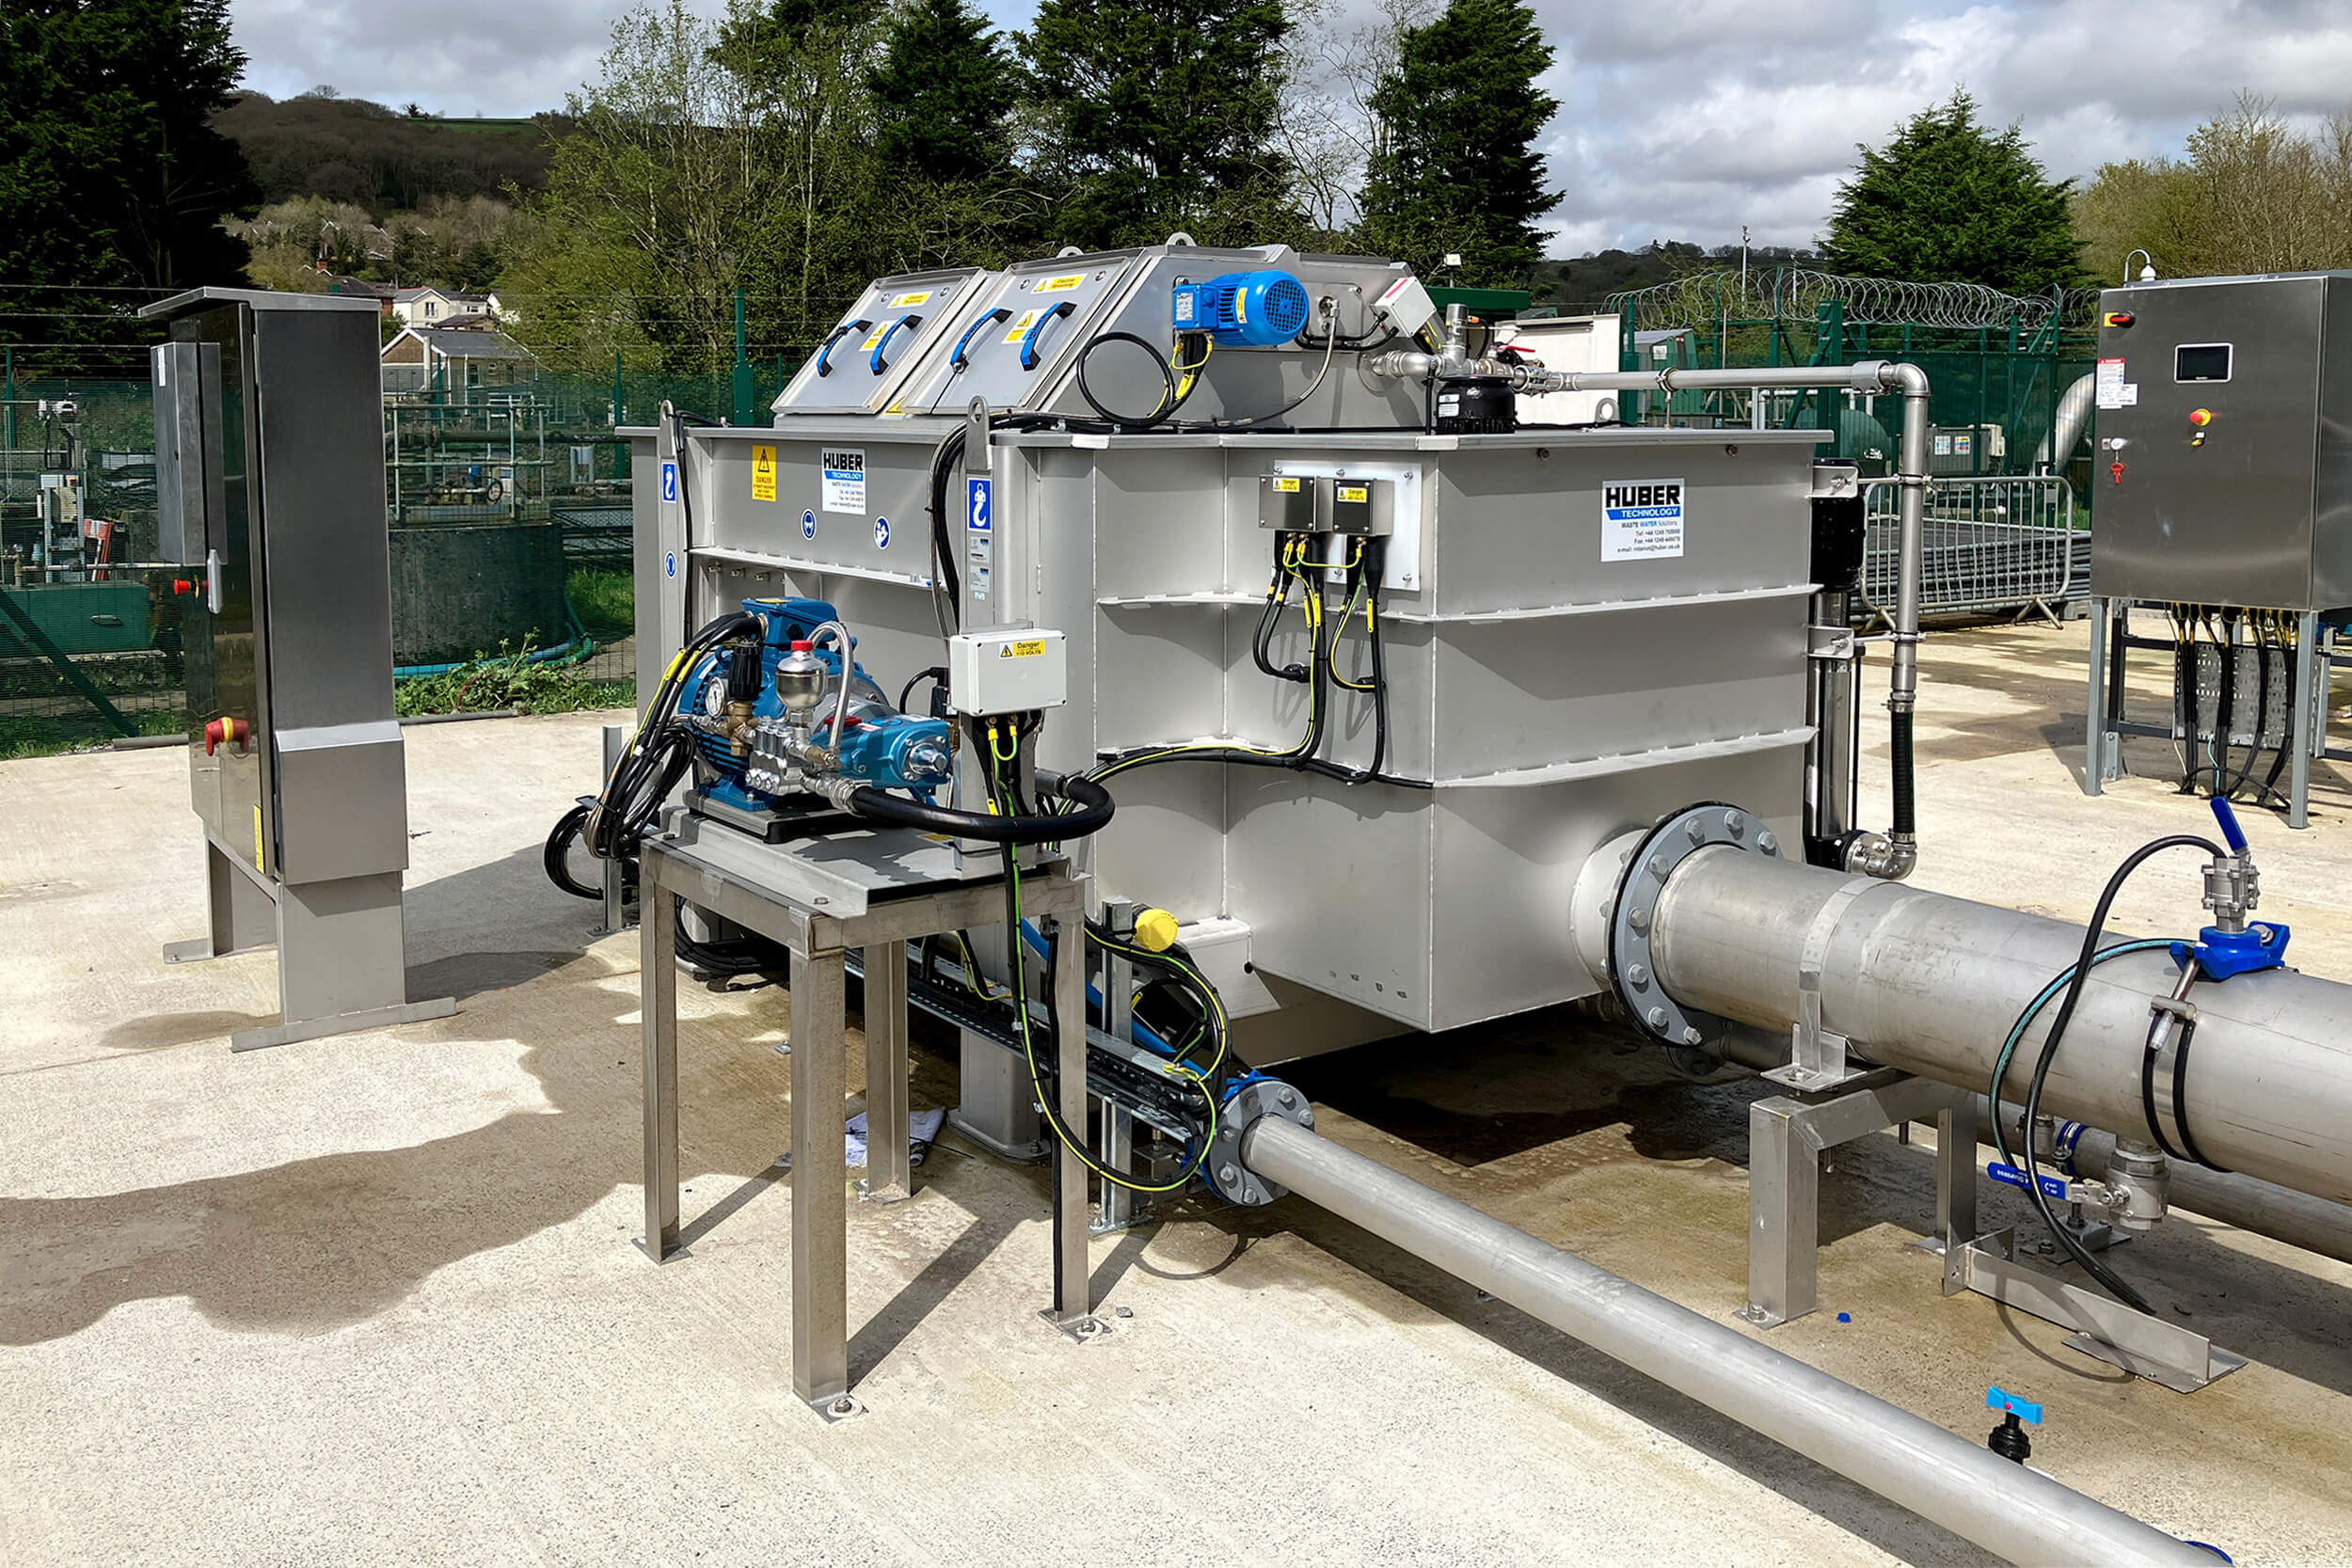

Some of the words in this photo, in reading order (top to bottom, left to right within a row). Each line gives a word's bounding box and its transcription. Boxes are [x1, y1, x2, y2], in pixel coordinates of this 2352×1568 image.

[823, 451, 864, 471] HUBER
[831, 472, 862, 481] TECHNOLOGY
[1605, 484, 1680, 508] HUBER
[1621, 508, 1678, 518] TECHNOLOGY
